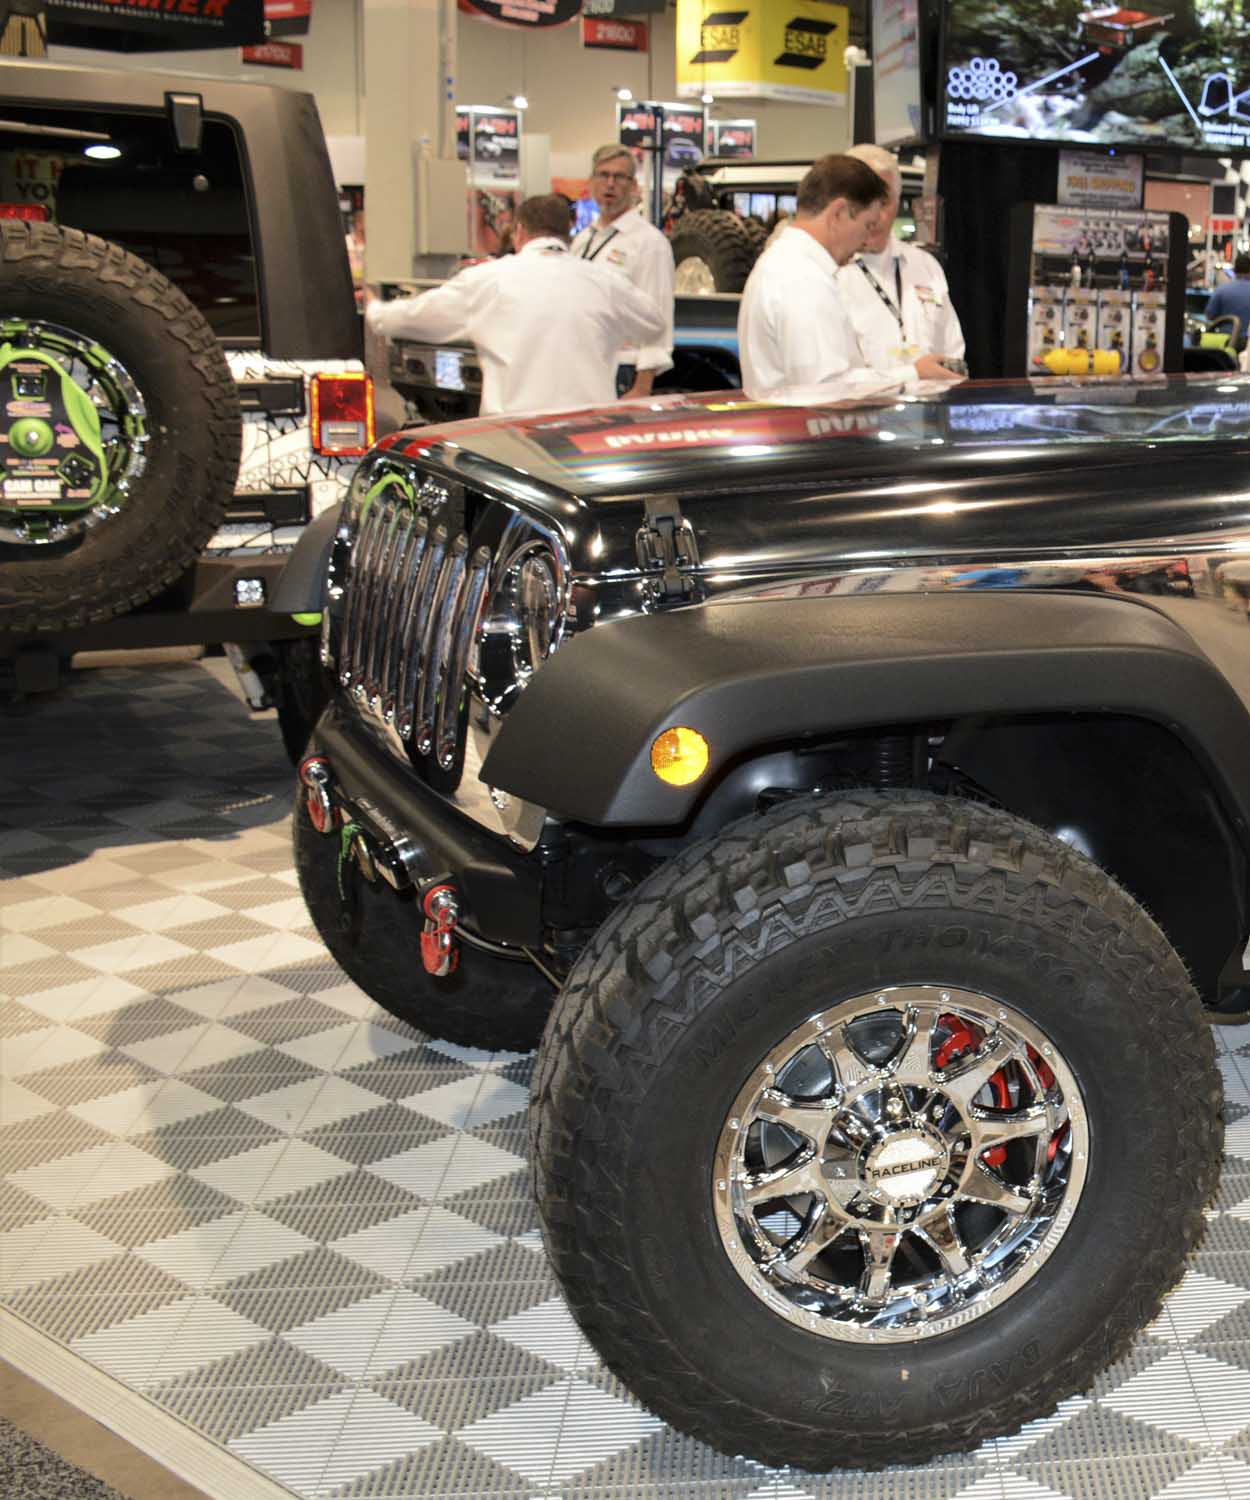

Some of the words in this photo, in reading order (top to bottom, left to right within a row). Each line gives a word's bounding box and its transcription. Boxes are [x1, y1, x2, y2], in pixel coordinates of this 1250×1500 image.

[701, 24, 740, 48] ESAB
[785, 29, 827, 56] ESAB
[872, 1157, 941, 1179] RACELINE
